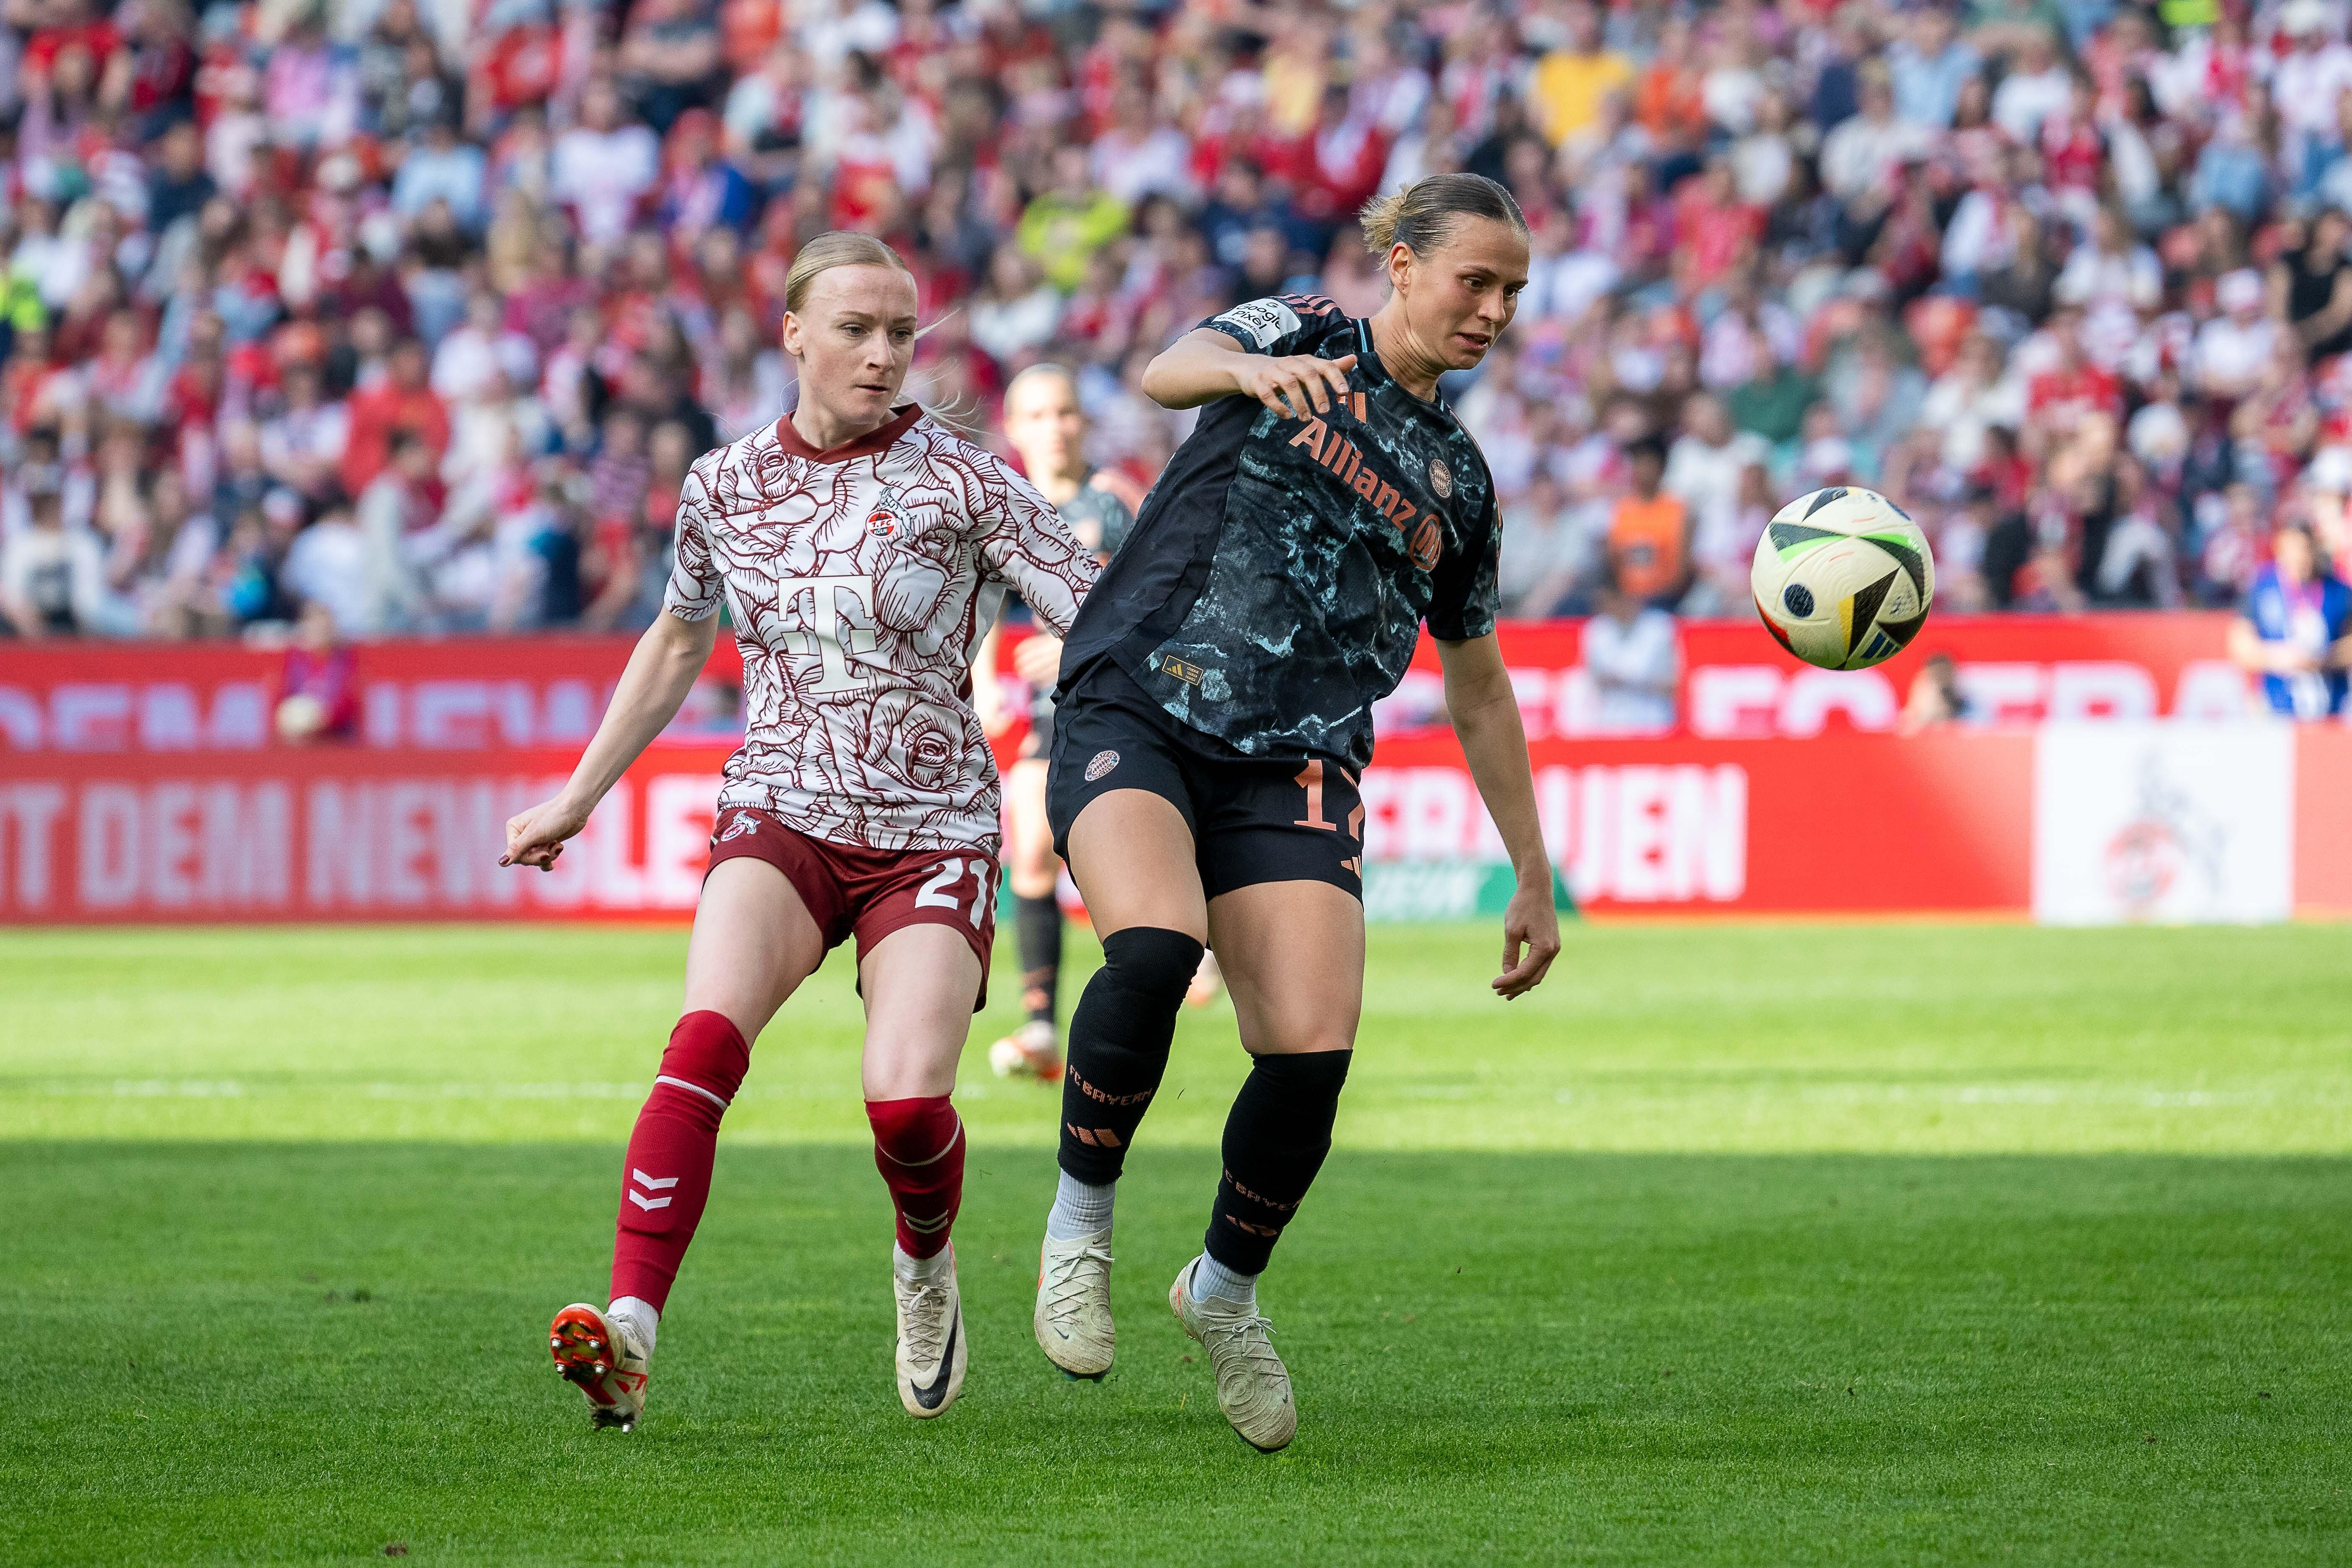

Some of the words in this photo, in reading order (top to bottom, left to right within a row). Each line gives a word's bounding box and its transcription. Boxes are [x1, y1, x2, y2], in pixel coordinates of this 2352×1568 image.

[1236, 304, 1280, 330] Google
[1288, 415, 1417, 533] Allianz
[778, 575, 877, 694] T
[81, 780, 290, 907] DEM
[915, 857, 989, 930] 21
[1070, 1064, 1081, 1086] FC
[1082, 1080, 1153, 1106] BAYERN
